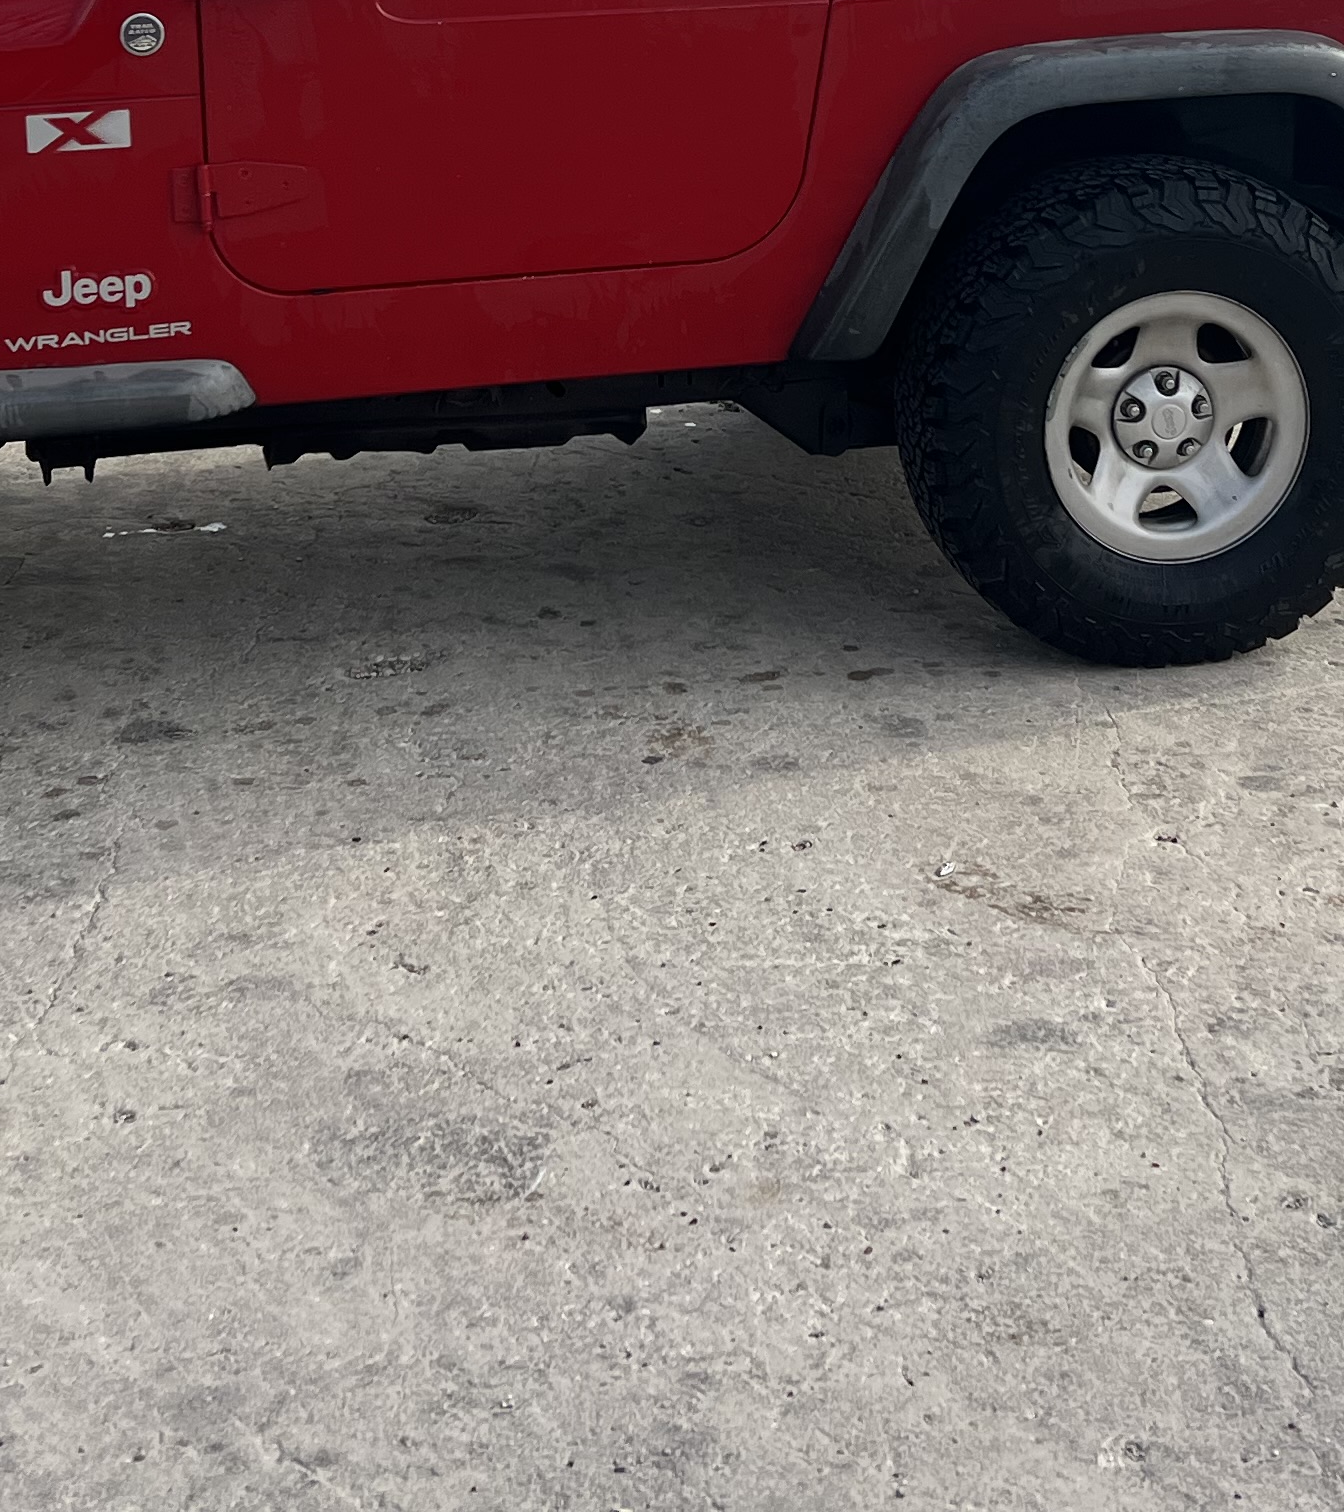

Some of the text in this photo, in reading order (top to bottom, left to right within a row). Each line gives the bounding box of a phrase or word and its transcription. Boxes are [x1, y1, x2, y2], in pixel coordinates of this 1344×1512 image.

[32, 109, 116, 154] X
[43, 271, 153, 308] Jeep
[4, 321, 192, 353] WRANGLER
